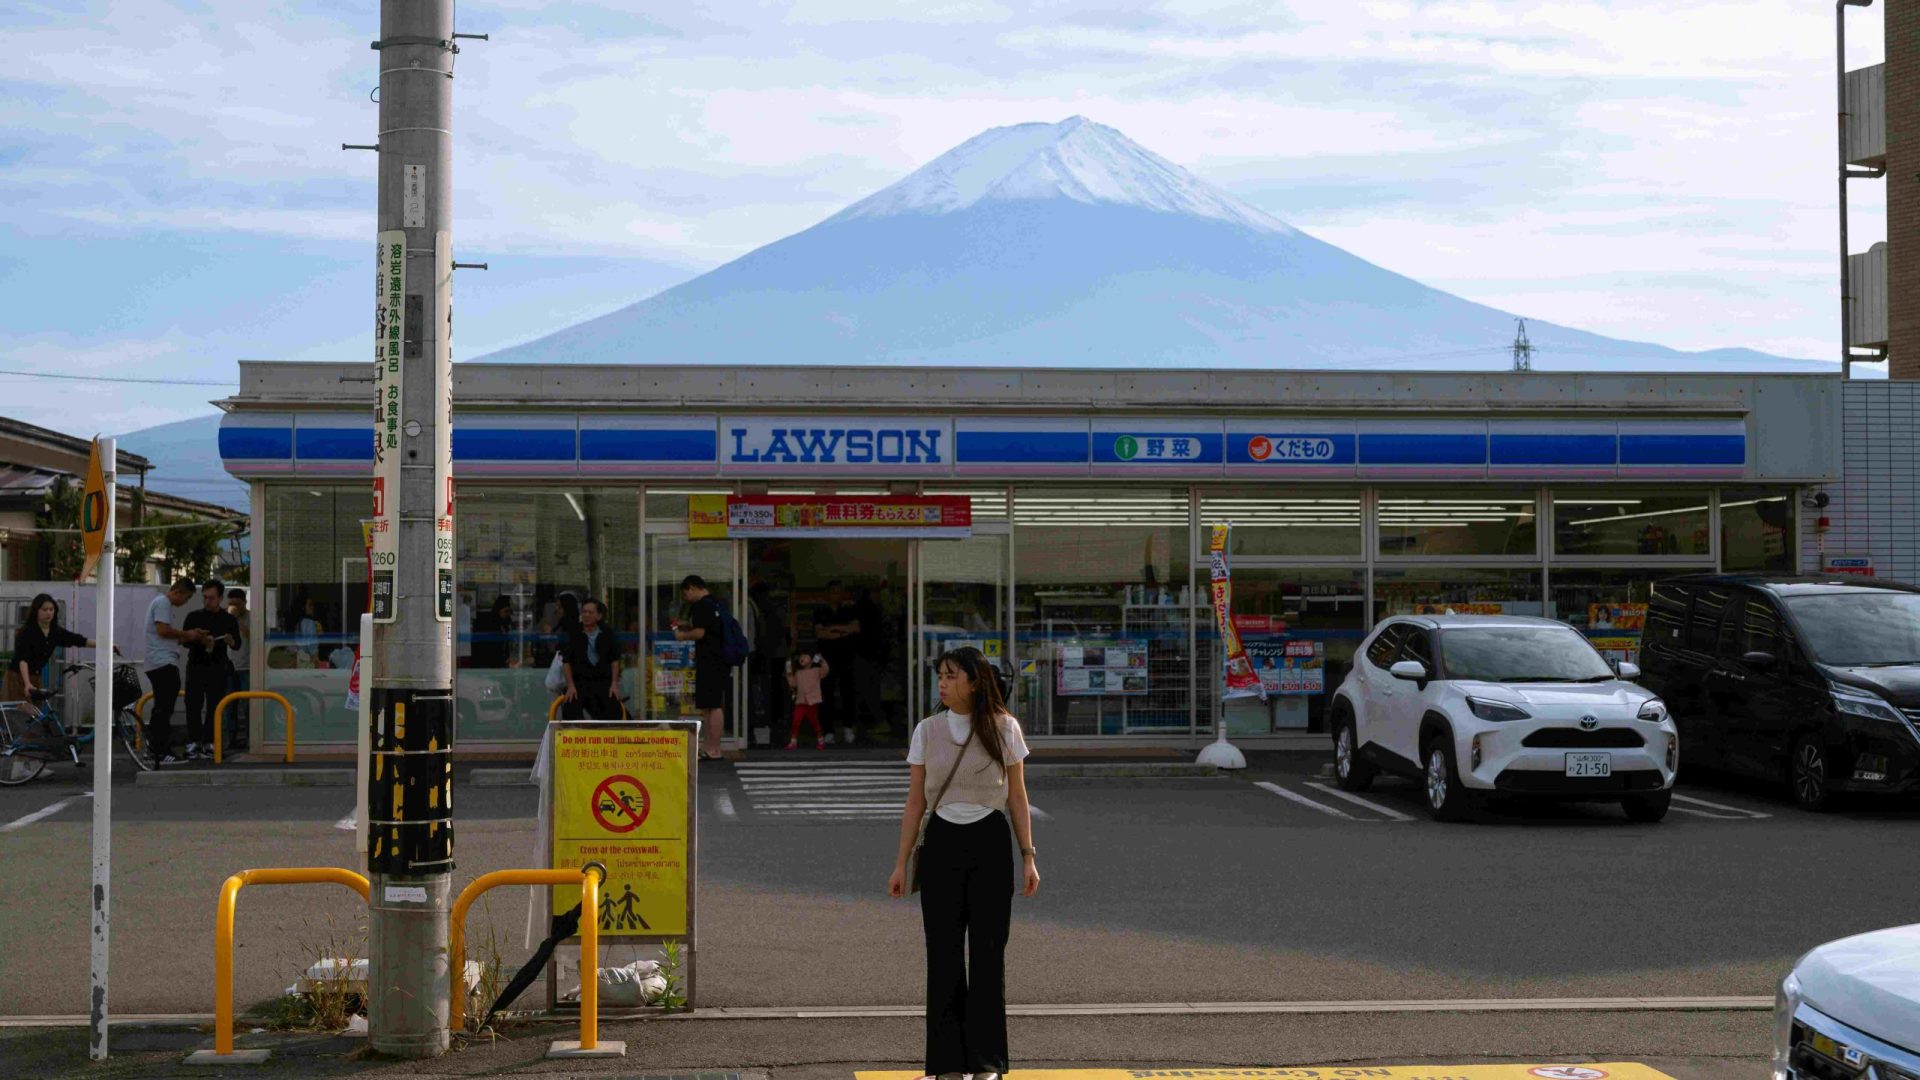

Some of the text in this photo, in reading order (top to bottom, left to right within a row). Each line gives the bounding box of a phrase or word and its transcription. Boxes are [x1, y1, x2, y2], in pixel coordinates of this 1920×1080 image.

[386, 244, 402, 449] 溶岩遠赤外線風呂 お食事処
[731, 428, 941, 463] LAWSON
[1146, 438, 1190, 457] 野菜
[1275, 440, 1330, 457] くだもの
[562, 736, 572, 744] Do
[574, 736, 587, 744] not
[588, 736, 601, 744] run
[603, 736, 616, 744] out
[617, 736, 633, 744] into
[634, 736, 646, 744] the
[1576, 763, 1608, 775] 21-50
[580, 846, 598, 854] Cross
[600, 846, 608, 854] at
[609, 846, 621, 854] the
[1132, 1069, 1318, 1078] Crossing
[1332, 1068, 1394, 1077] NO
